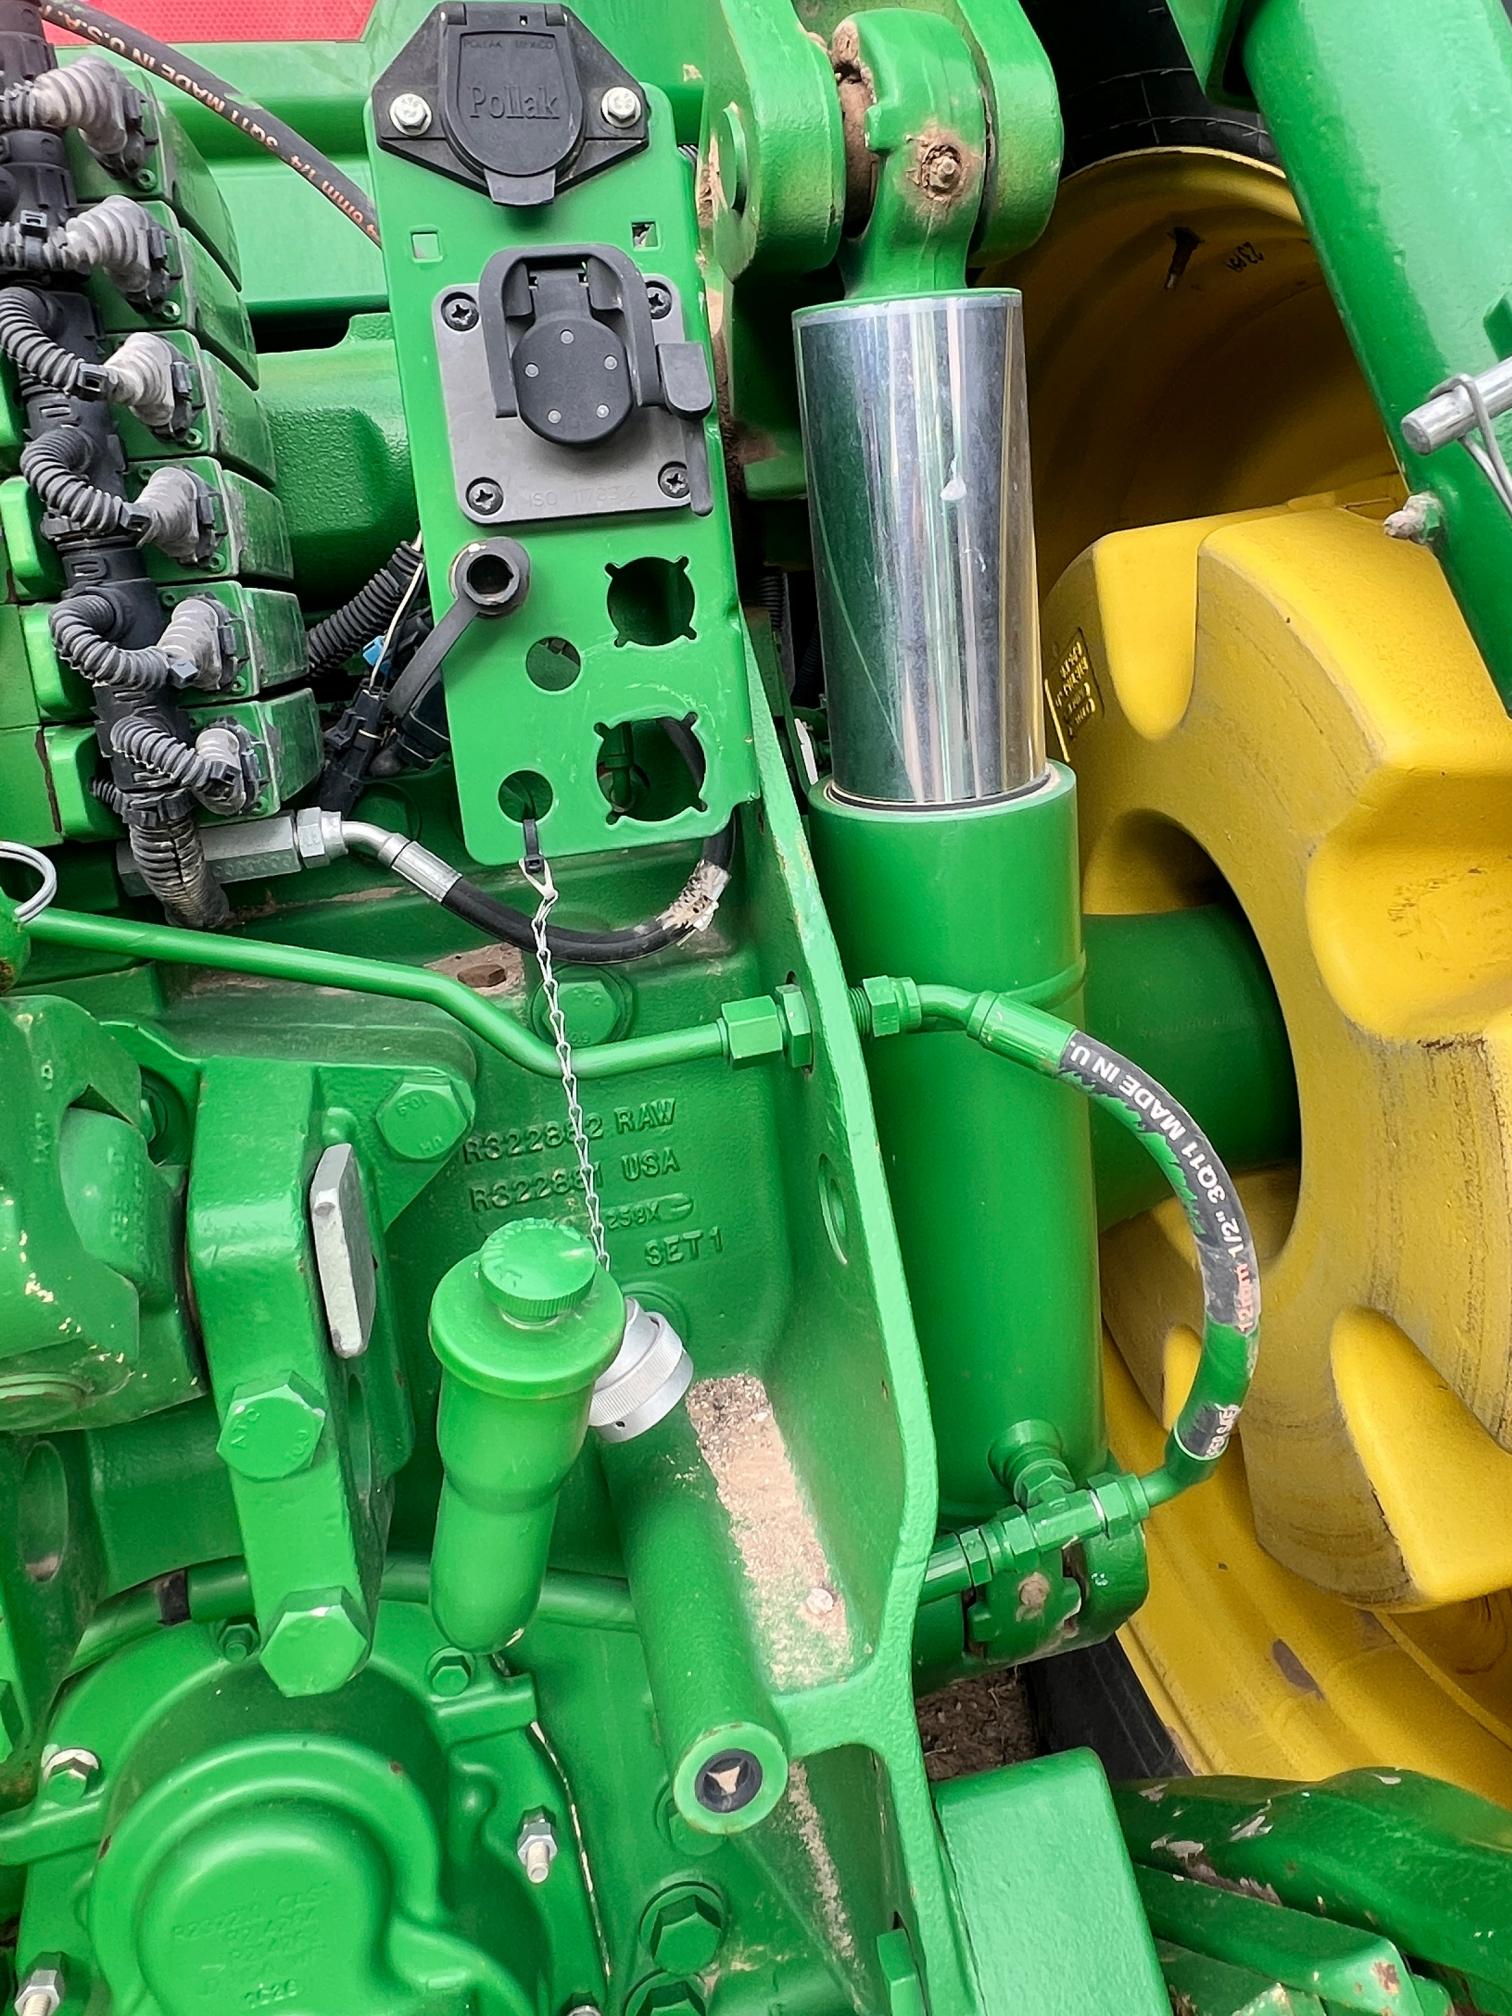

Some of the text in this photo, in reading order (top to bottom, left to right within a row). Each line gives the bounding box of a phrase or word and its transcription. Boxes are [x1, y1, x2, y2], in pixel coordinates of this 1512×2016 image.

[132, 48, 155, 67] IN
[161, 63, 225, 113] MADE
[467, 84, 561, 120] Pollak
[528, 489, 558, 508] ISO
[1092, 1056, 1117, 1084] IN
[614, 1097, 676, 1134] RAW
[1119, 1073, 1187, 1141] MADE
[622, 1146, 680, 1181] USA
[1181, 1140, 1227, 1205] 3Q11
[644, 1225, 724, 1266] SET 1
